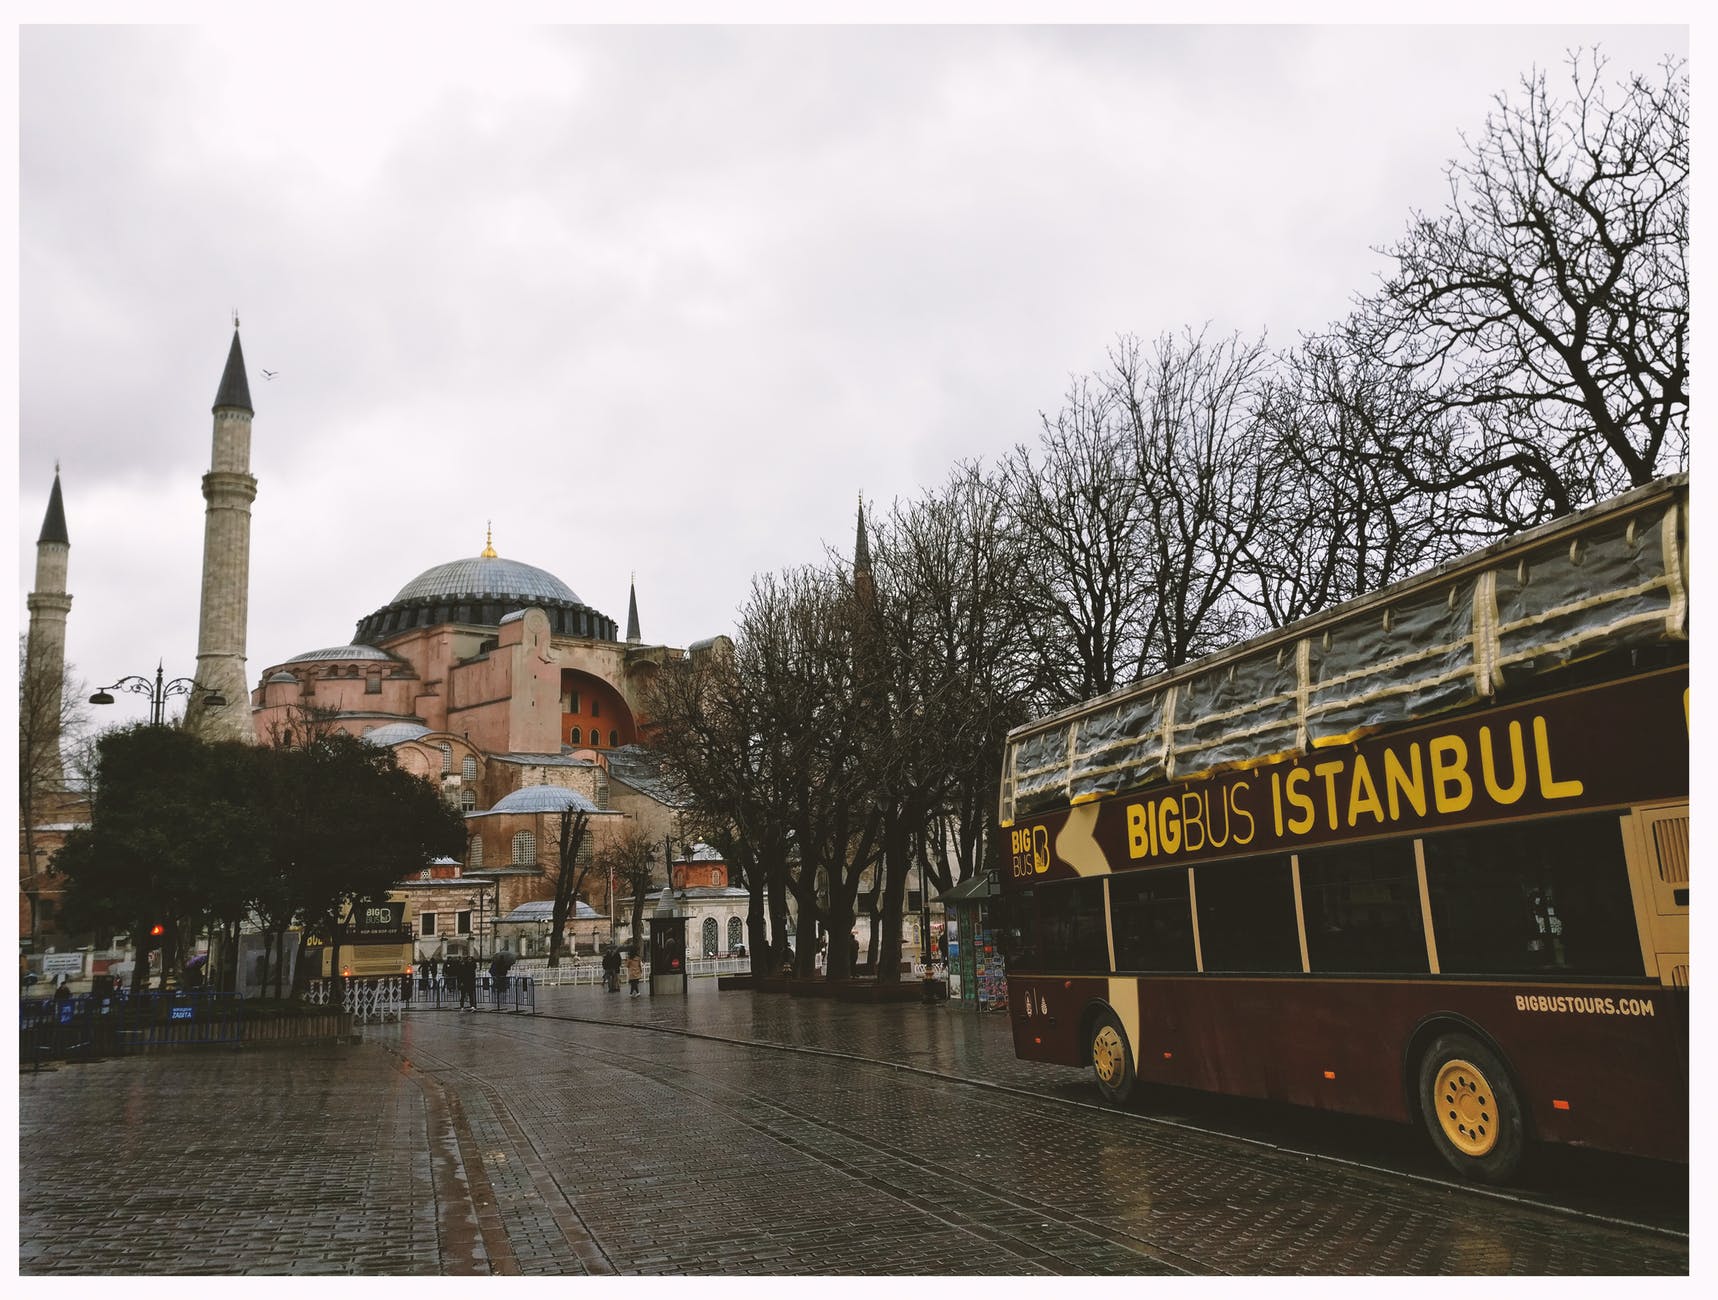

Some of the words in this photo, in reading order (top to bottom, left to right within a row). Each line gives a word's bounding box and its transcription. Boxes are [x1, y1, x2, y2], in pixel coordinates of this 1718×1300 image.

[1271, 716, 1584, 837] ISTANBUL
[1011, 828, 1031, 855] BIG
[1012, 853, 1033, 878] BUS
[366, 908, 380, 916] BIG
[1515, 995, 1655, 1017] BIGBUSTOURS.COM
